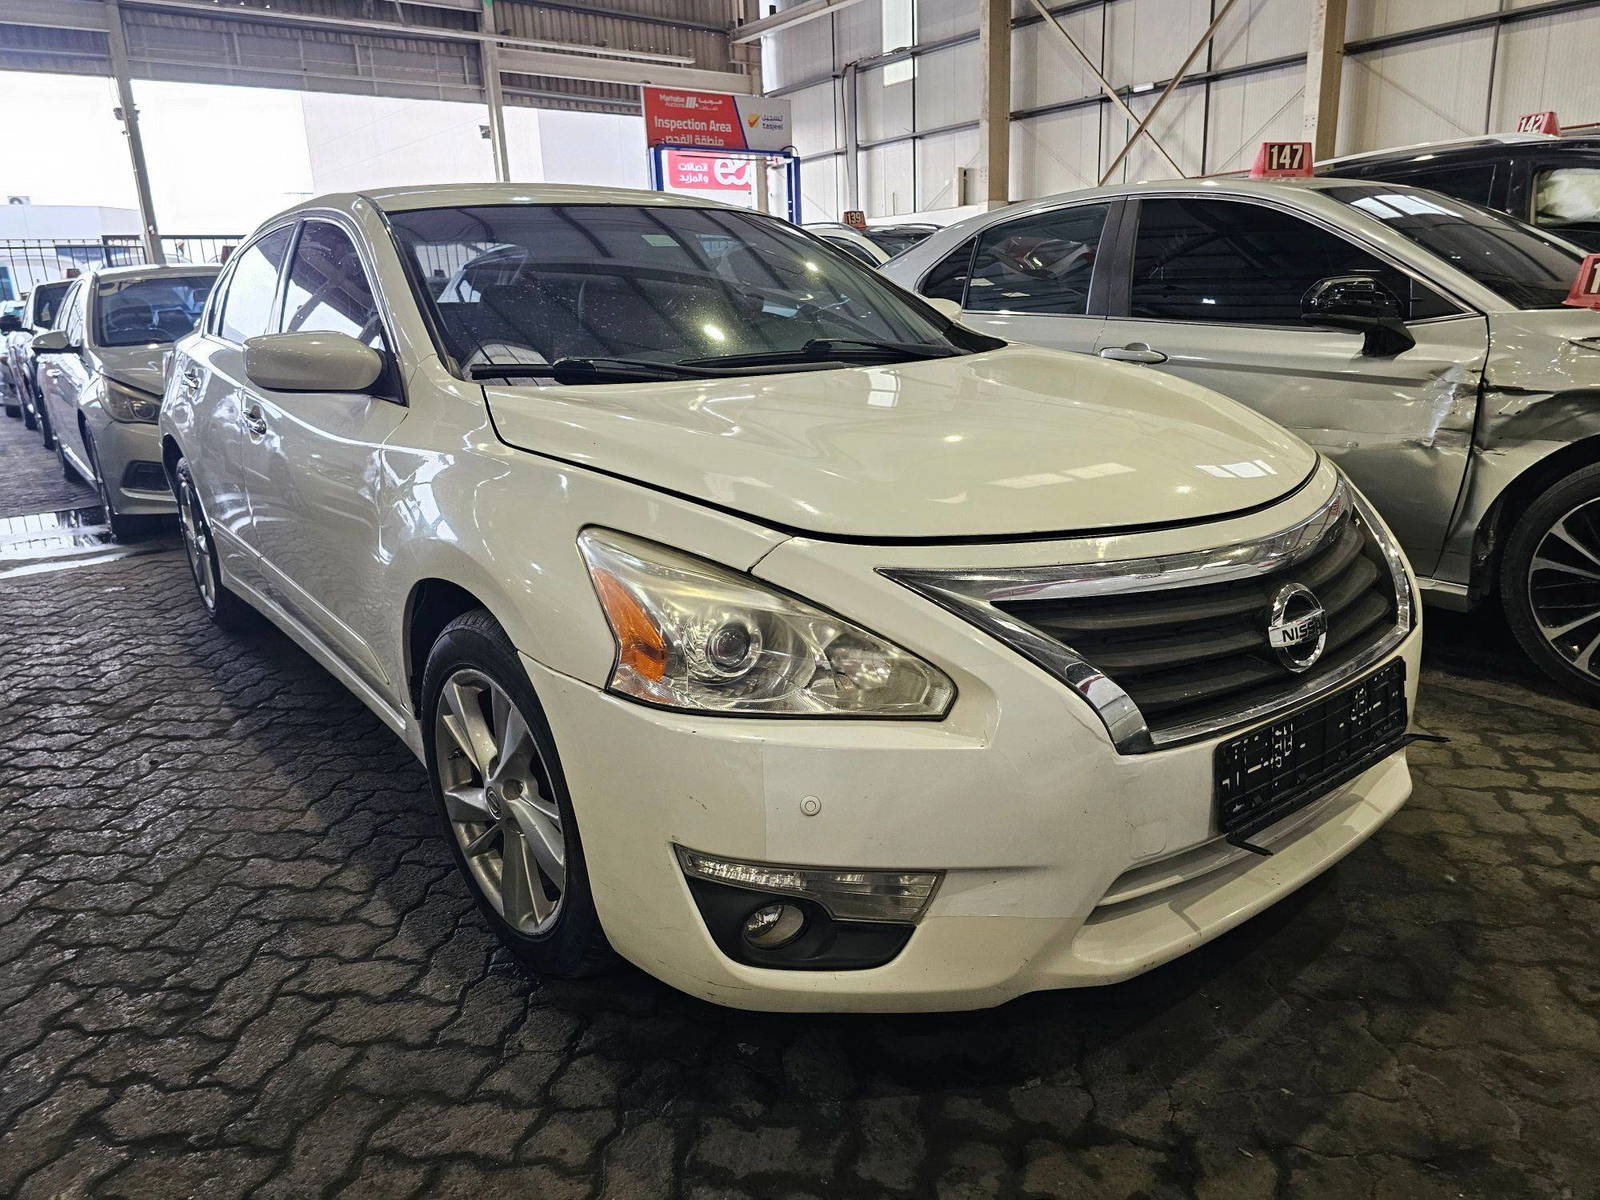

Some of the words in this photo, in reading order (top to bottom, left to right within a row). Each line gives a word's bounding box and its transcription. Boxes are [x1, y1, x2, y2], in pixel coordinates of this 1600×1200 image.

[654, 115, 707, 131] Inspection
[709, 119, 732, 132] Area
[1519, 114, 1543, 133] 142
[694, 134, 724, 146] منطقة
[1271, 144, 1303, 169] 147
[848, 211, 861, 224] 139
